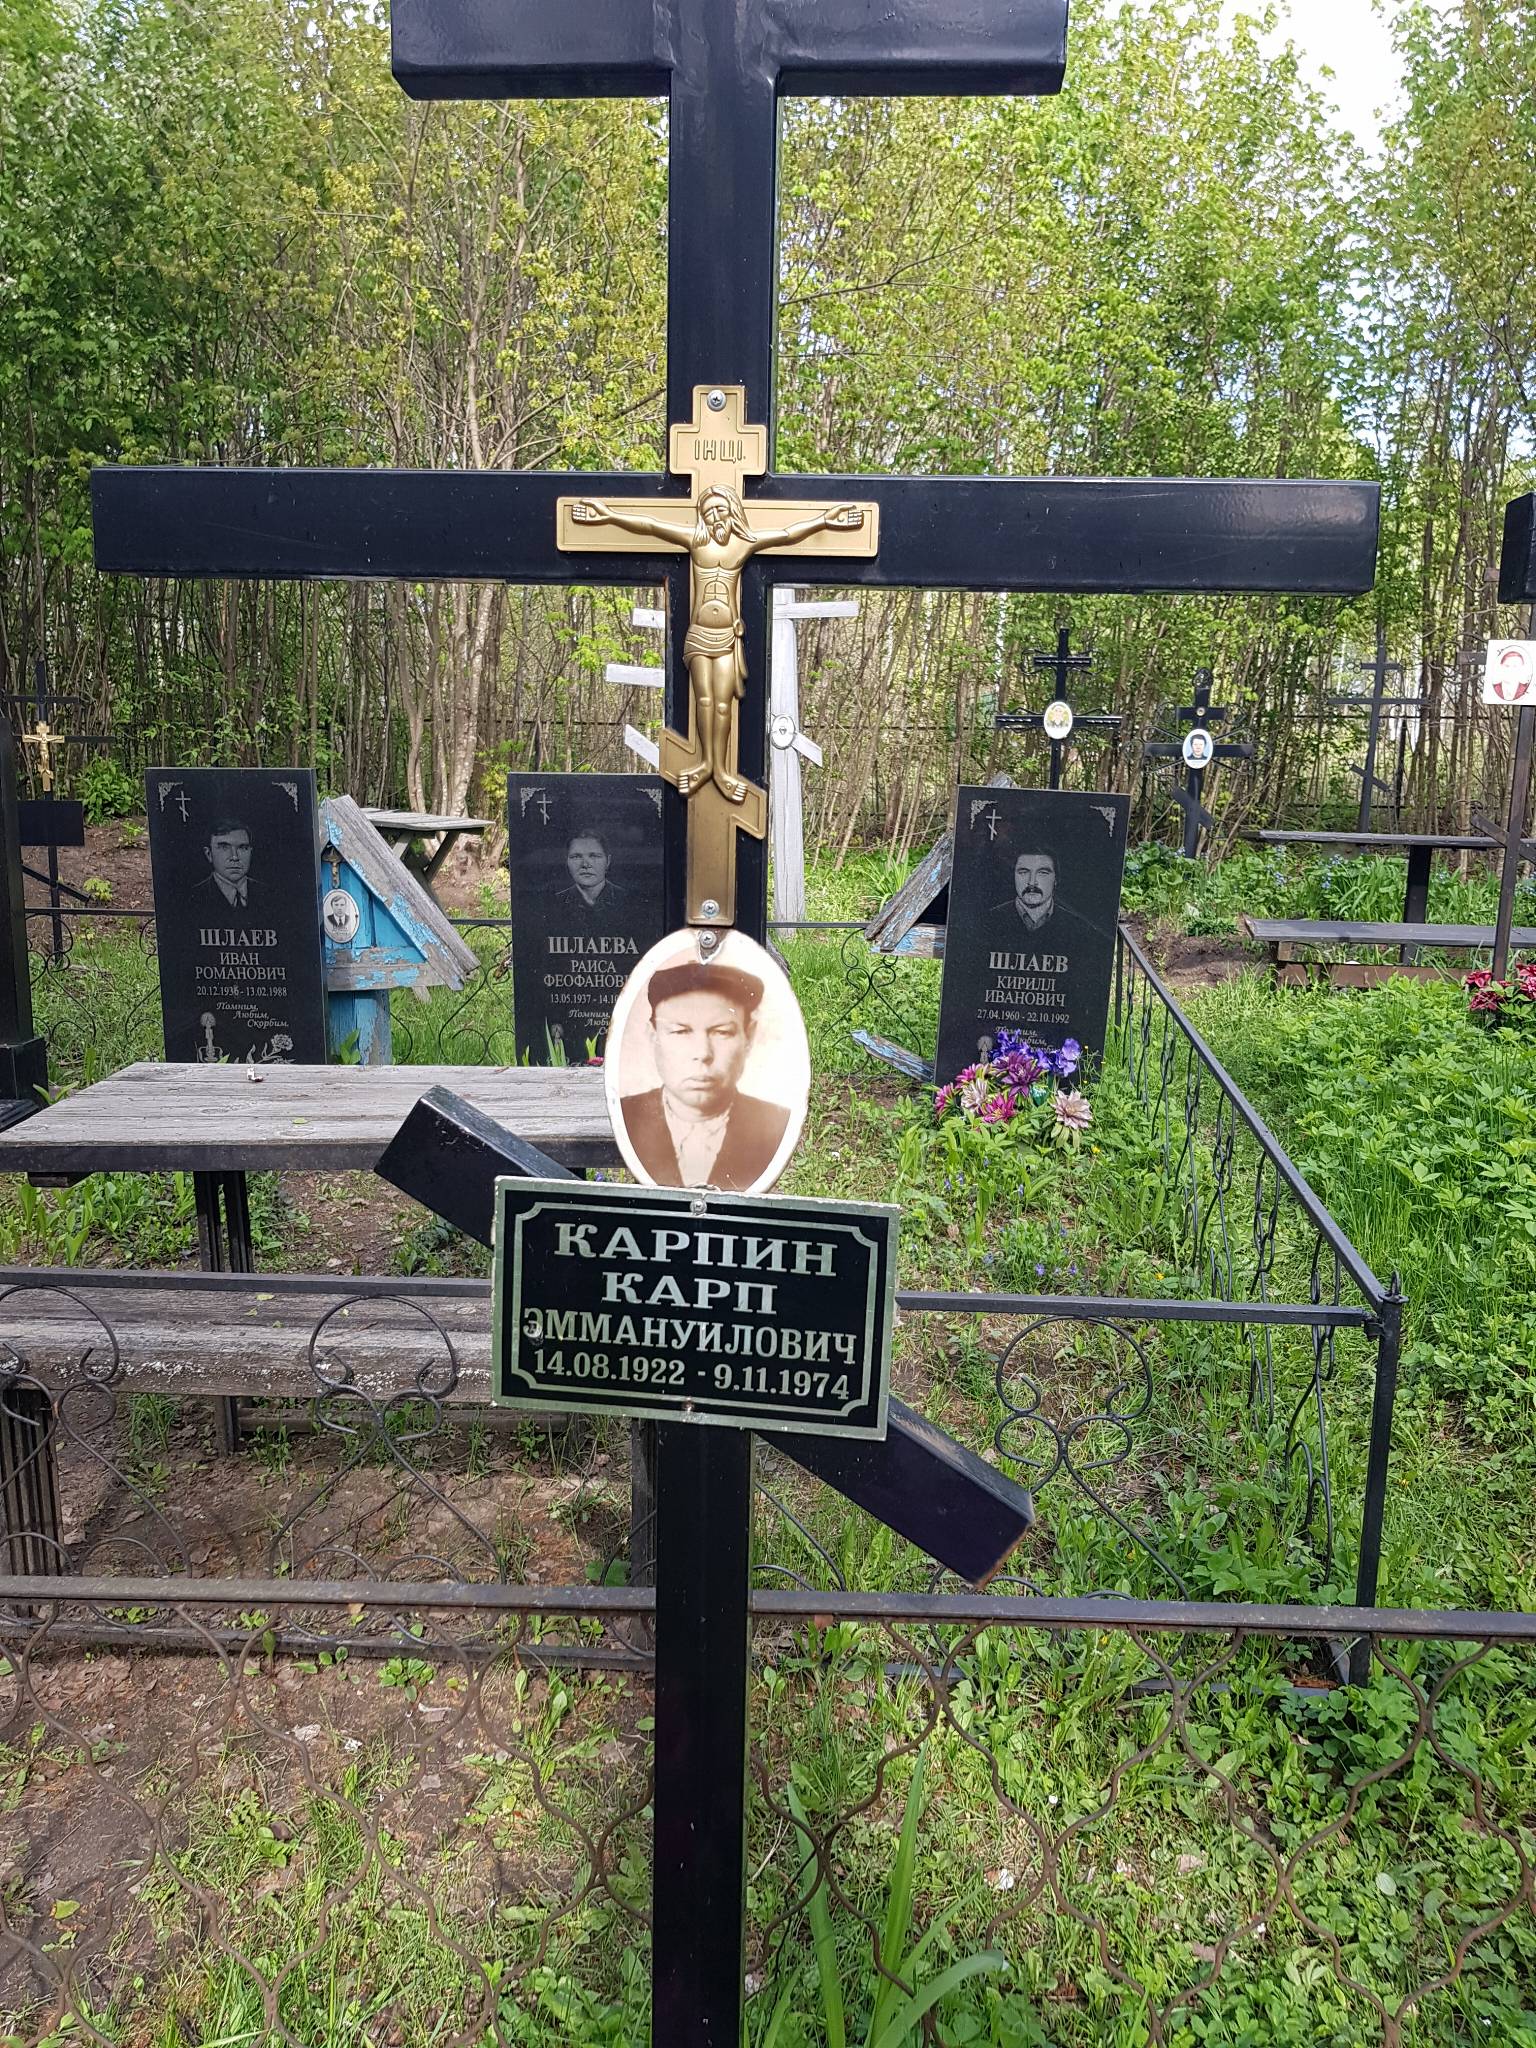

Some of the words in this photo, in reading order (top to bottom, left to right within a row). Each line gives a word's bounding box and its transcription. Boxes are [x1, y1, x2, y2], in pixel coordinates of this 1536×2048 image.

[199, 928, 279, 947] ШЛАЕВ
[547, 936, 641, 954] ШЛАЕВА
[219, 952, 260, 966] ИВАН
[570, 959, 617, 973] РАИСА
[988, 951, 1070, 973] ШЛАЕВ
[195, 966, 287, 981] РОМАНОВИЧ
[246, 986, 288, 997] 13.02.1988
[996, 975, 1057, 992] КИРИЛЛ
[550, 994, 592, 1005] 13.05.1937
[984, 989, 1067, 1007] ИВАНОВИЧ
[977, 1008, 1020, 1021] 27.04.1960
[1026, 1012, 1070, 1024] 22.10.1992
[553, 1222, 839, 1278] КАРПИН
[601, 1271, 779, 1316] КАРП
[522, 1307, 857, 1365] ЭММАНУИЛОВИЧ
[533, 1348, 686, 1386] 14.08.1922
[697, 1369, 707, 1377] -
[713, 1363, 850, 1401] 9.11.1974
